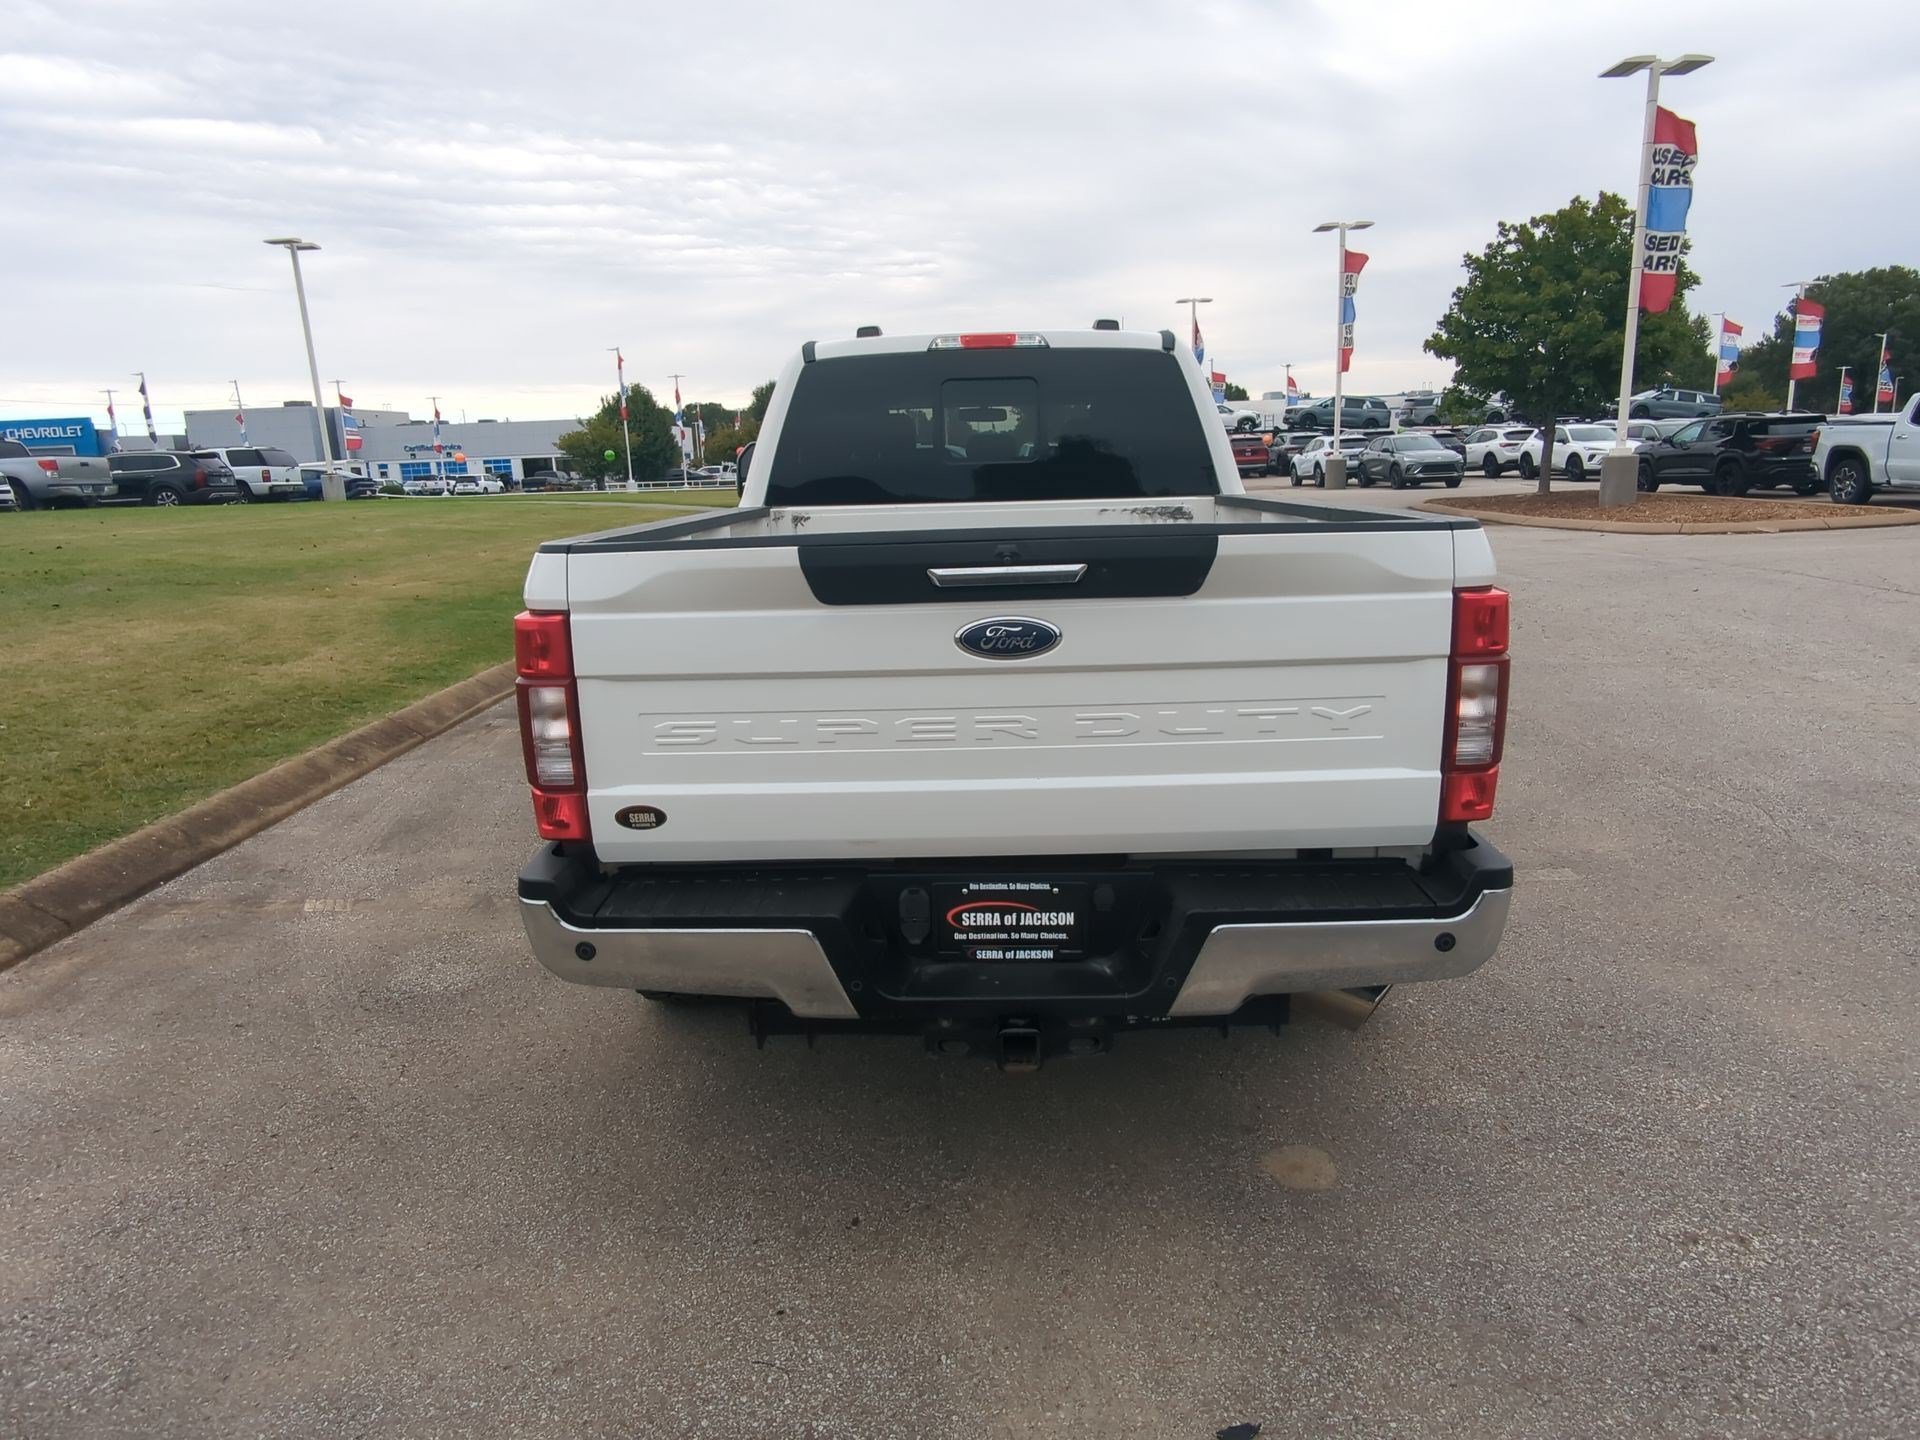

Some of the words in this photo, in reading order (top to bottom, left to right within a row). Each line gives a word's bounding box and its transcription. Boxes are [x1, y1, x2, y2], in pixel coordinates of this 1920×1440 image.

[1651, 168, 1692, 185] CARS
[1643, 255, 1677, 272] ARS
[6, 425, 83, 439] CHEVROLET
[980, 625, 1037, 650] Ford
[654, 715, 1039, 746] SUPER
[1075, 705, 1371, 738] DUTY
[629, 812, 656, 823] SERRA
[961, 912, 1001, 926] SERRA
[1004, 912, 1017, 926] of
[1019, 912, 1075, 926] JACKSON
[954, 932, 967, 940] One
[968, 931, 1009, 940] Destination.
[1010, 932, 1019, 940] So
[1021, 931, 1039, 940] Many
[1040, 931, 1069, 940] Choices.
[976, 950, 1003, 959] SERRA
[1005, 950, 1015, 959] of
[1015, 949, 1054, 959] JACKSON
